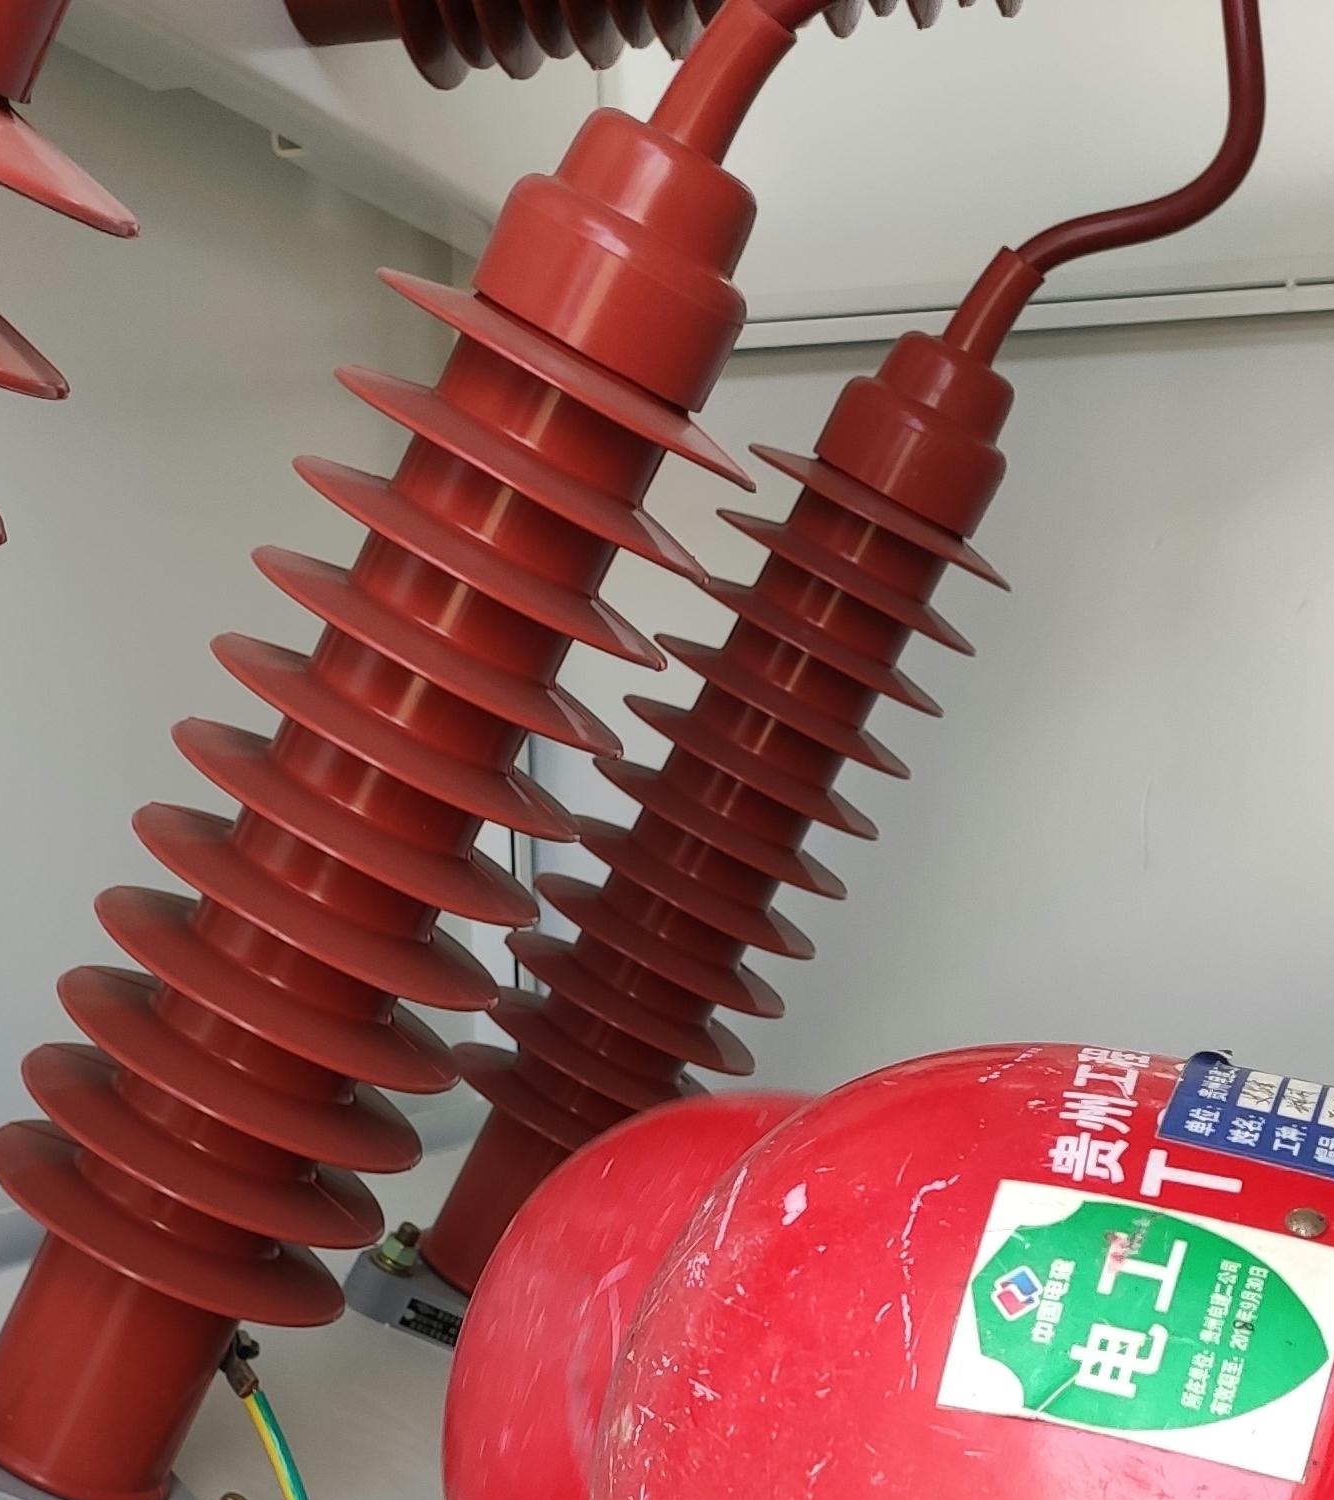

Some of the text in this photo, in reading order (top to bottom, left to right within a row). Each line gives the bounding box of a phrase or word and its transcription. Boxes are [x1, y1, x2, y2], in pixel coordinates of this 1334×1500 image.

[1226, 1114, 1266, 1147] 姓名：
[1273, 1124, 1307, 1157] 工种：
[1031, 1258, 1075, 1345] 中国电建
[1069, 1233, 1188, 1398] 电工
